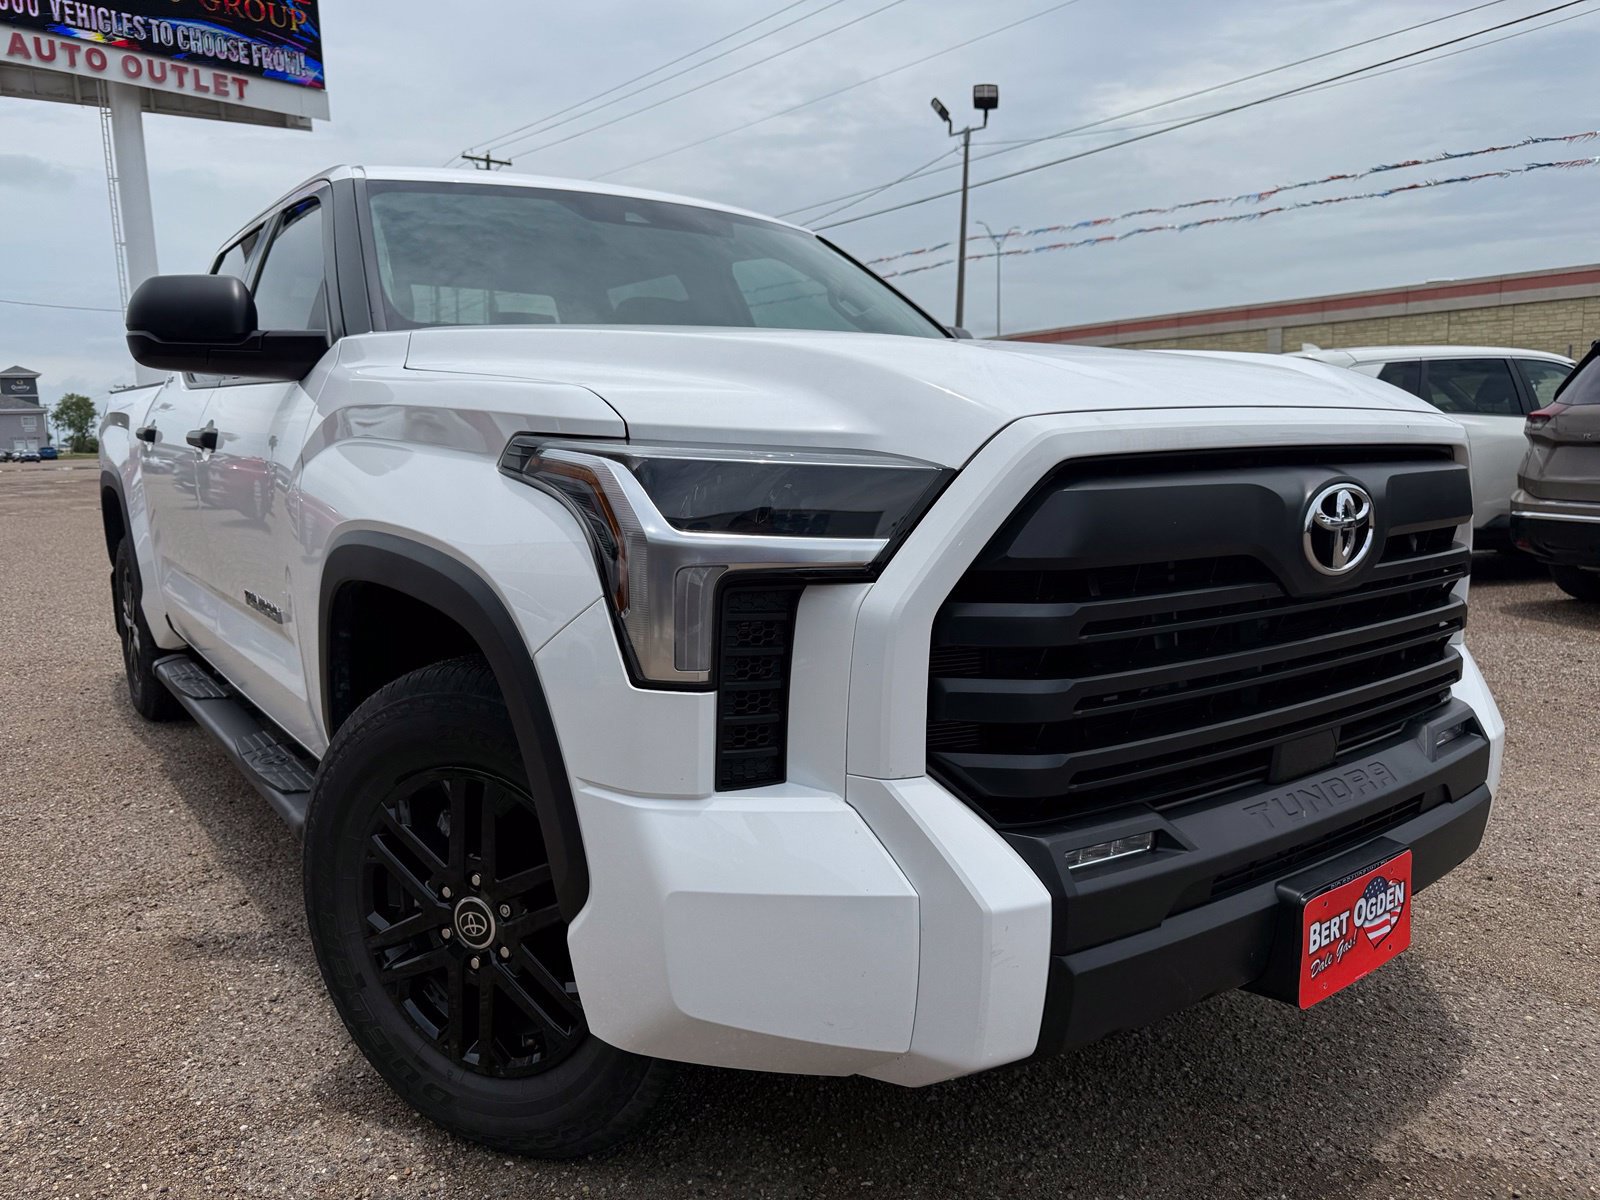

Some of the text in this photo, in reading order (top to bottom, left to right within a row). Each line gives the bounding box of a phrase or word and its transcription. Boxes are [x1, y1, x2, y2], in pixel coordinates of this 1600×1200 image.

[6, 32, 249, 99] AUTO OUTLET
[50, 0, 147, 41] VEHICLES
[148, 18, 174, 47] TO
[177, 24, 250, 65] CHOOSE
[251, 42, 307, 77] FROM!
[1242, 761, 1397, 828] TUNDRA
[1308, 881, 1404, 954] BERT OGDEN
